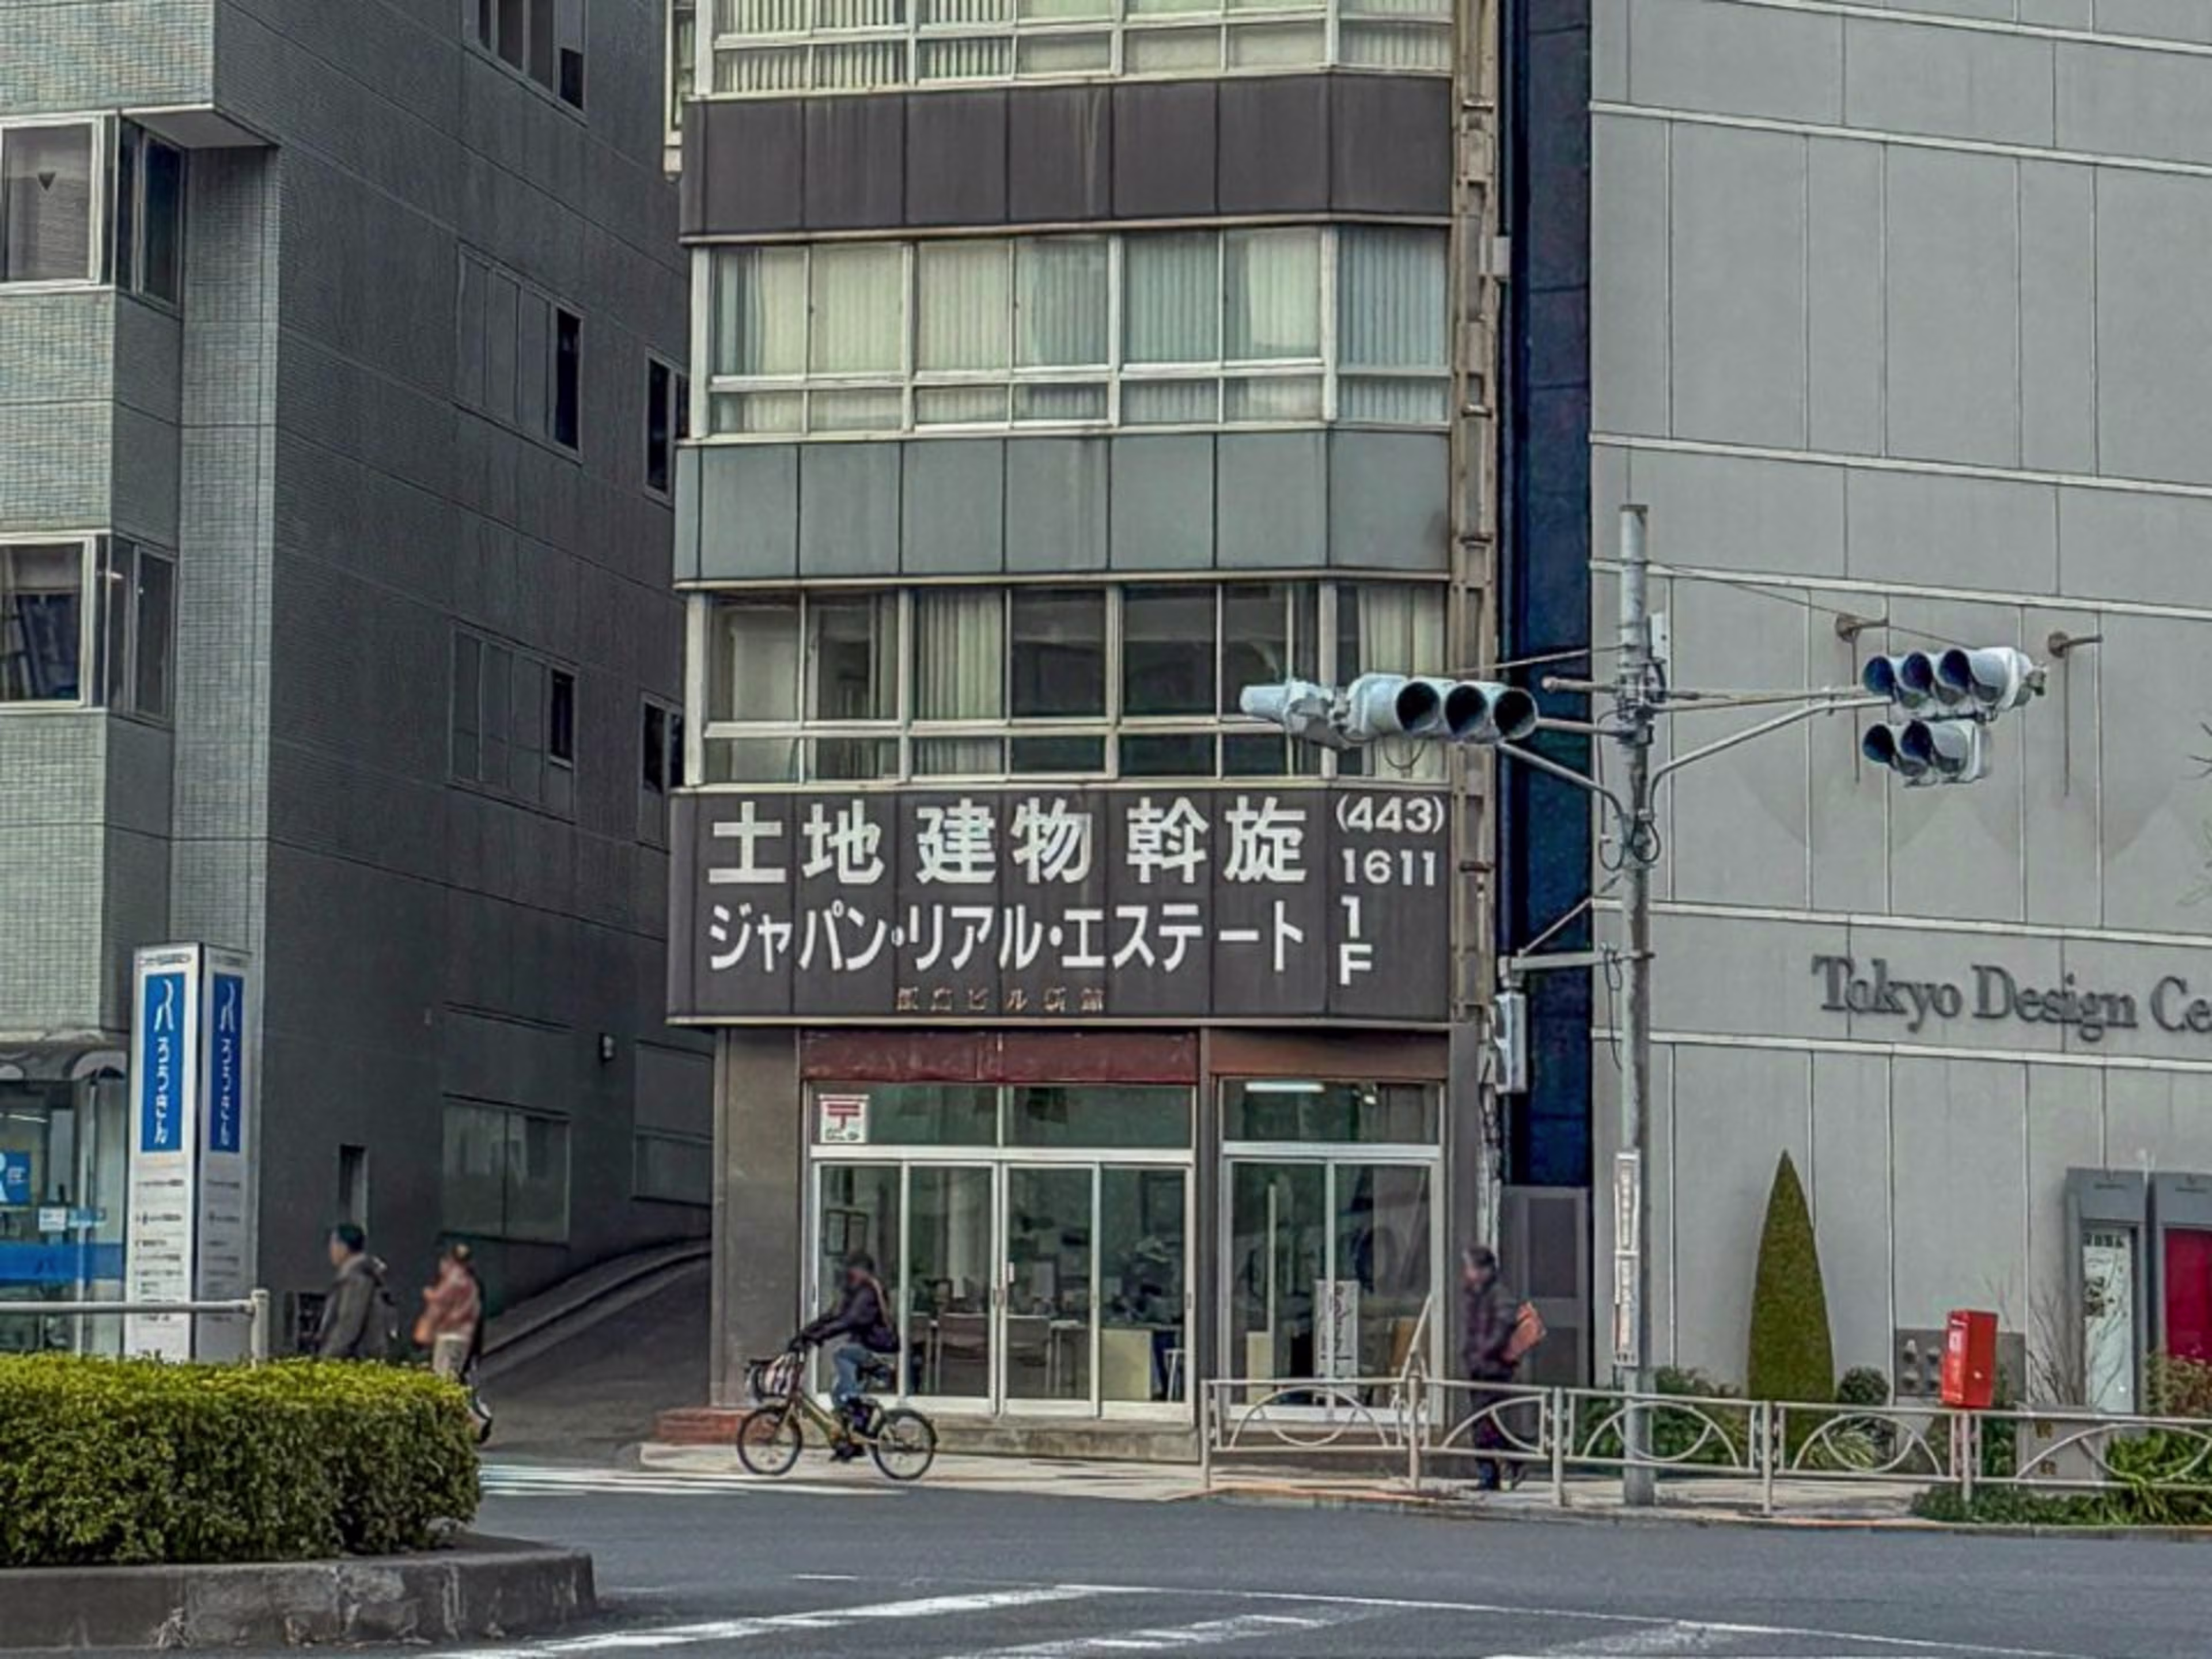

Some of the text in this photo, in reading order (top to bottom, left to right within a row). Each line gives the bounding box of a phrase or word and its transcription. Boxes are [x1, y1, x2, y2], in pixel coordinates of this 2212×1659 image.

[709, 796, 1306, 884] 土地 建物 斡旋
[1336, 794, 1445, 834] (443)
[1342, 848, 1436, 887] 1611
[1811, 955, 1963, 1033] Tokyo
[1971, 965, 2139, 1042] Design
